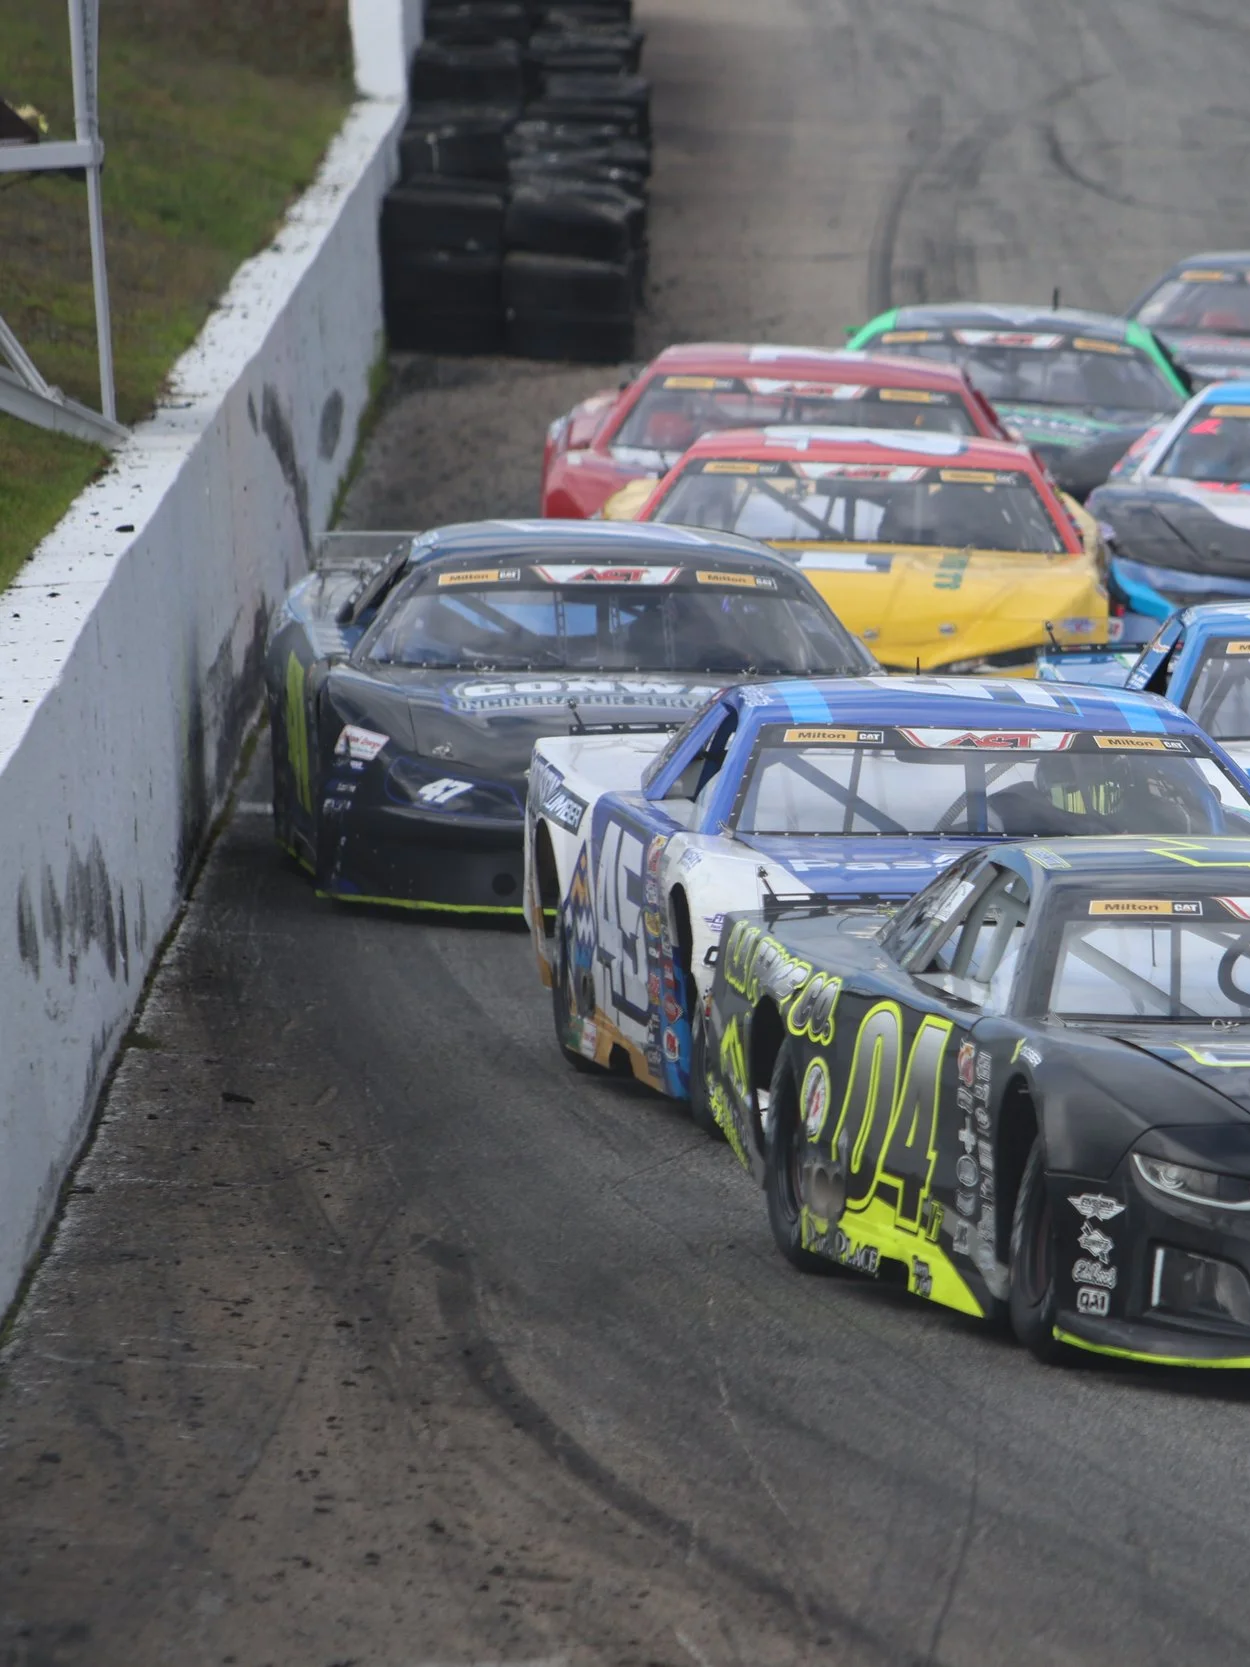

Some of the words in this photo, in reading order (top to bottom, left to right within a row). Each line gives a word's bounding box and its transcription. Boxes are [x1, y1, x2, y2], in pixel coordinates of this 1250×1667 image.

[565, 567, 649, 583] ACT
[797, 731, 846, 740] Milton
[859, 732, 881, 741] CAT
[942, 732, 1042, 749] ACT
[1107, 738, 1154, 748] Milton
[1163, 740, 1184, 750] CAT
[416, 778, 475, 804] 47
[1104, 902, 1160, 912] Milton
[1173, 903, 1199, 912] CAT
[831, 1000, 954, 1236] 04
